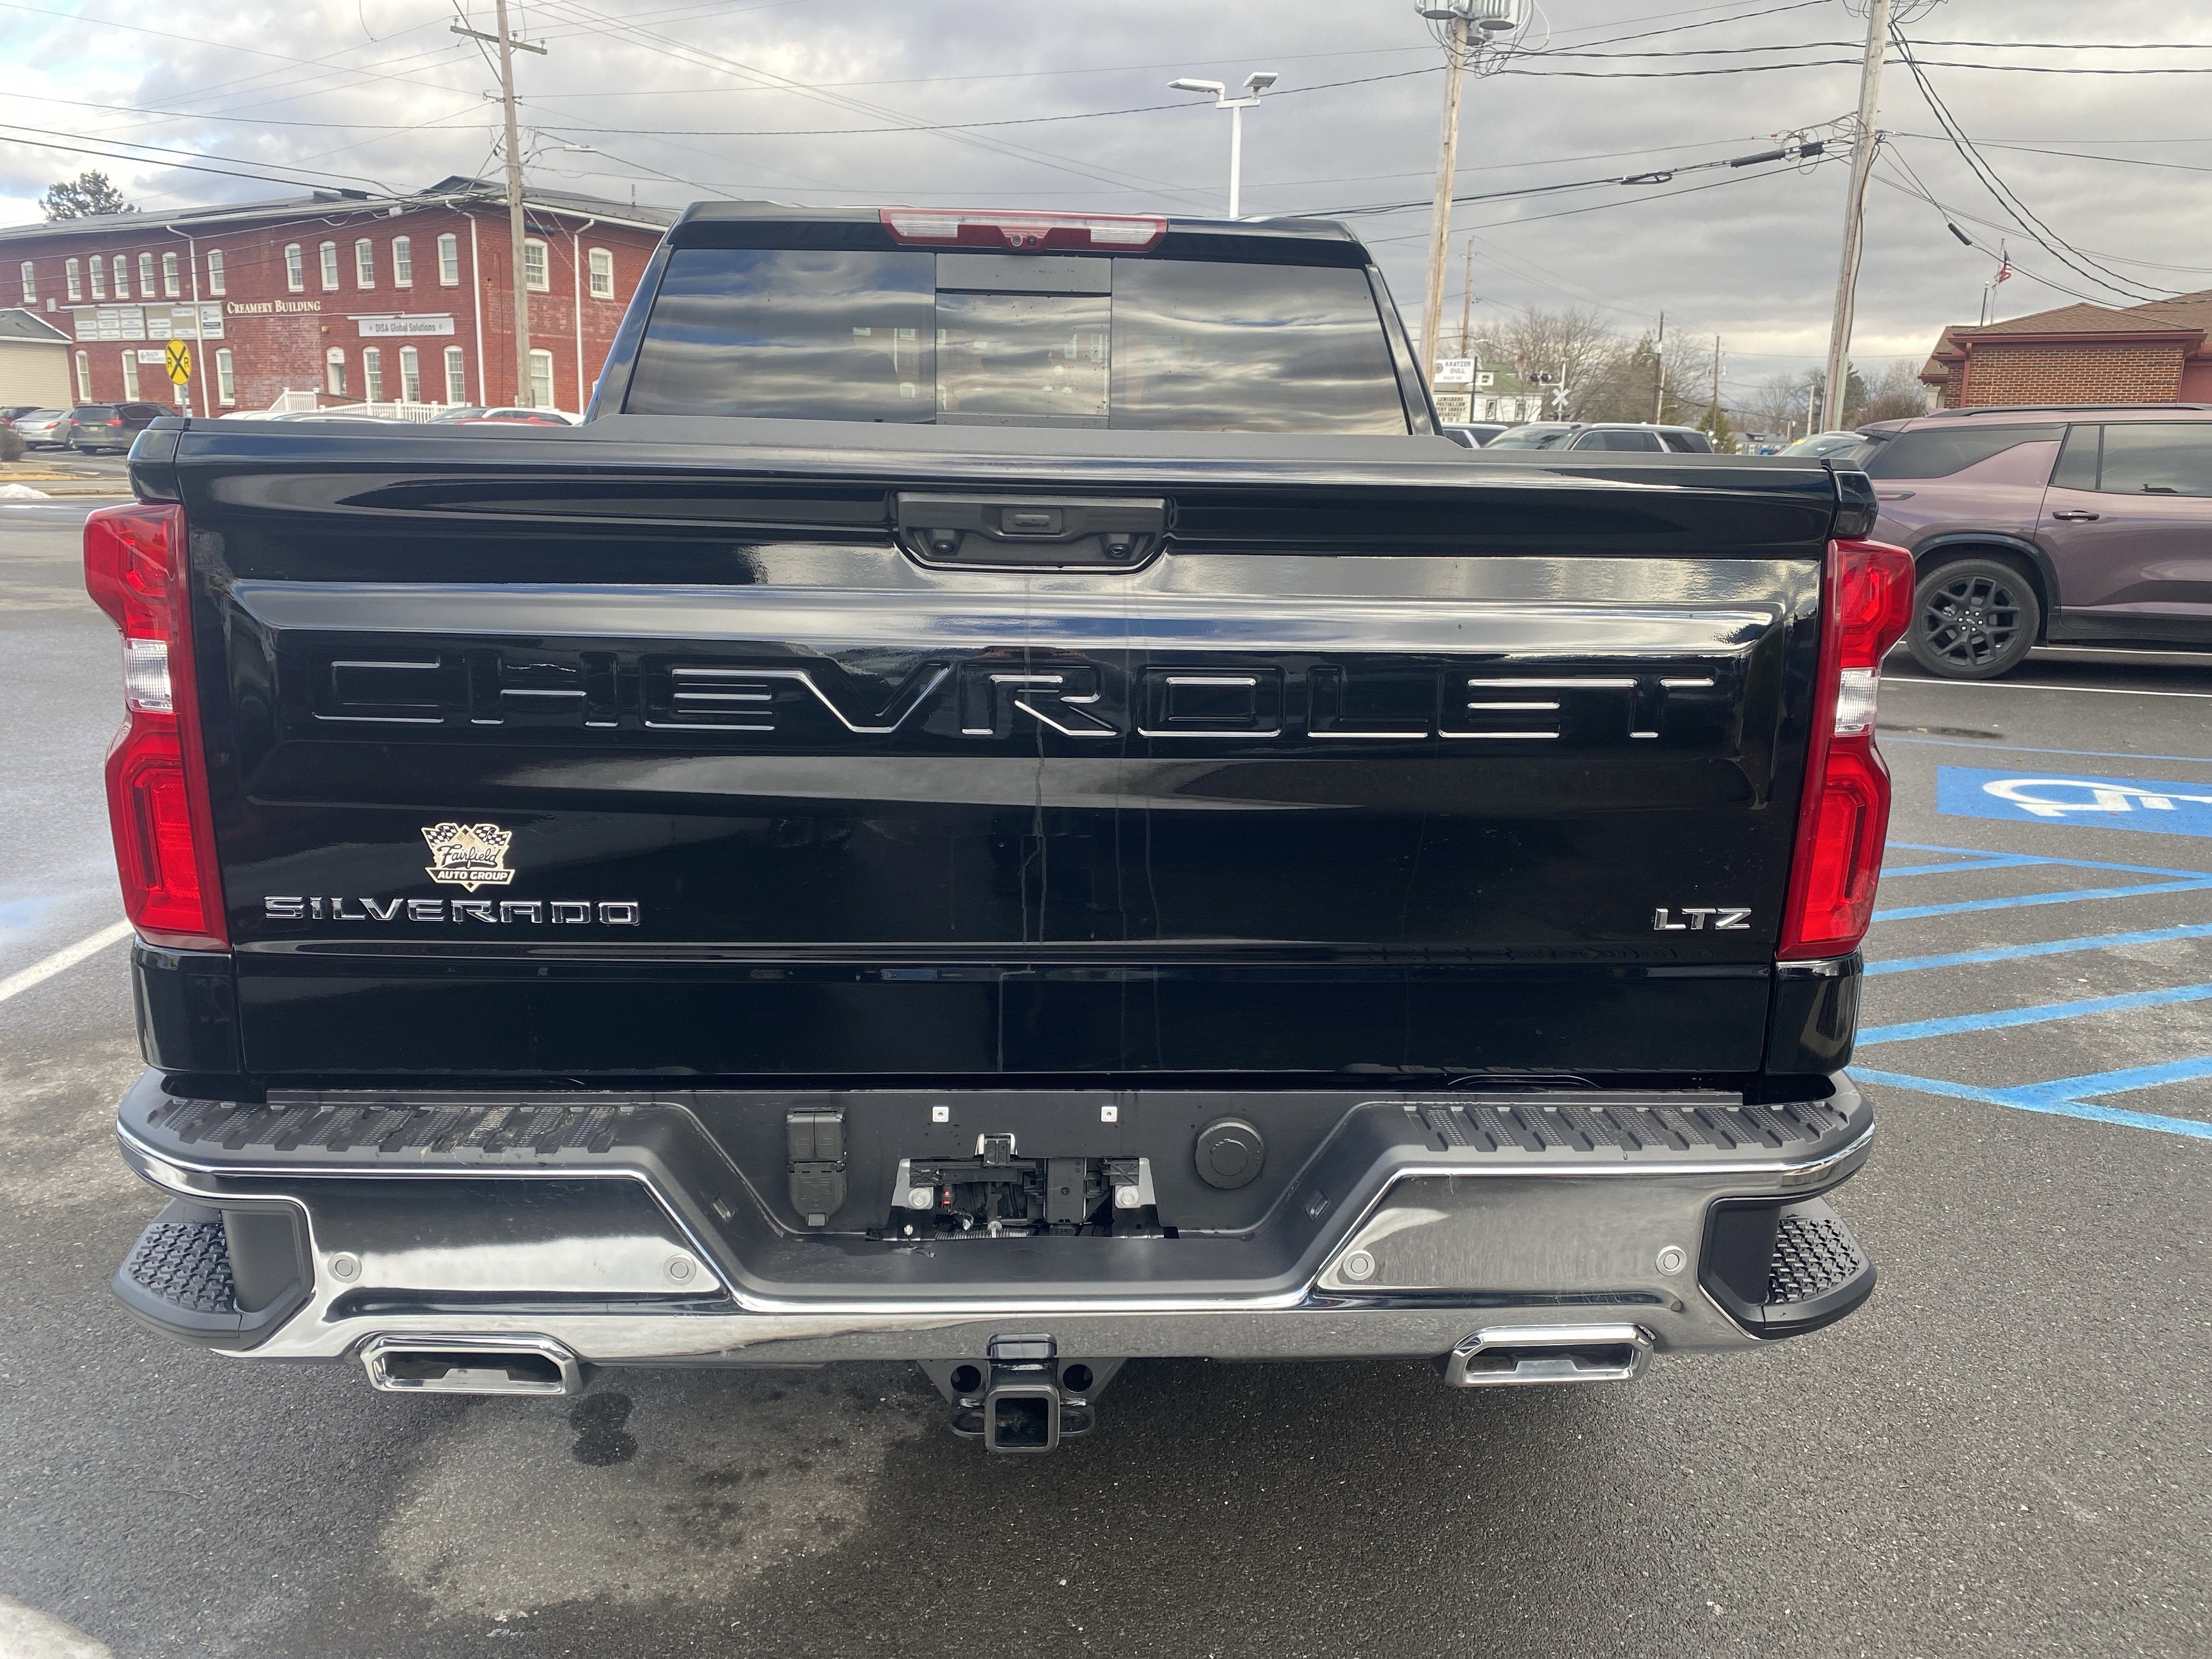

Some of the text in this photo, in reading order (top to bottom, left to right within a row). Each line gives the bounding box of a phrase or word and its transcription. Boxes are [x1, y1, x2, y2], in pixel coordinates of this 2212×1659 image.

[375, 322, 436, 332] DISA Global Solutions
[312, 650, 1717, 738] CHEVROLET
[437, 844, 501, 867] Fairfield
[437, 871, 507, 880] AUTO GROUP
[264, 896, 640, 924] SILVERADO
[1654, 908, 1752, 930] LTZ
